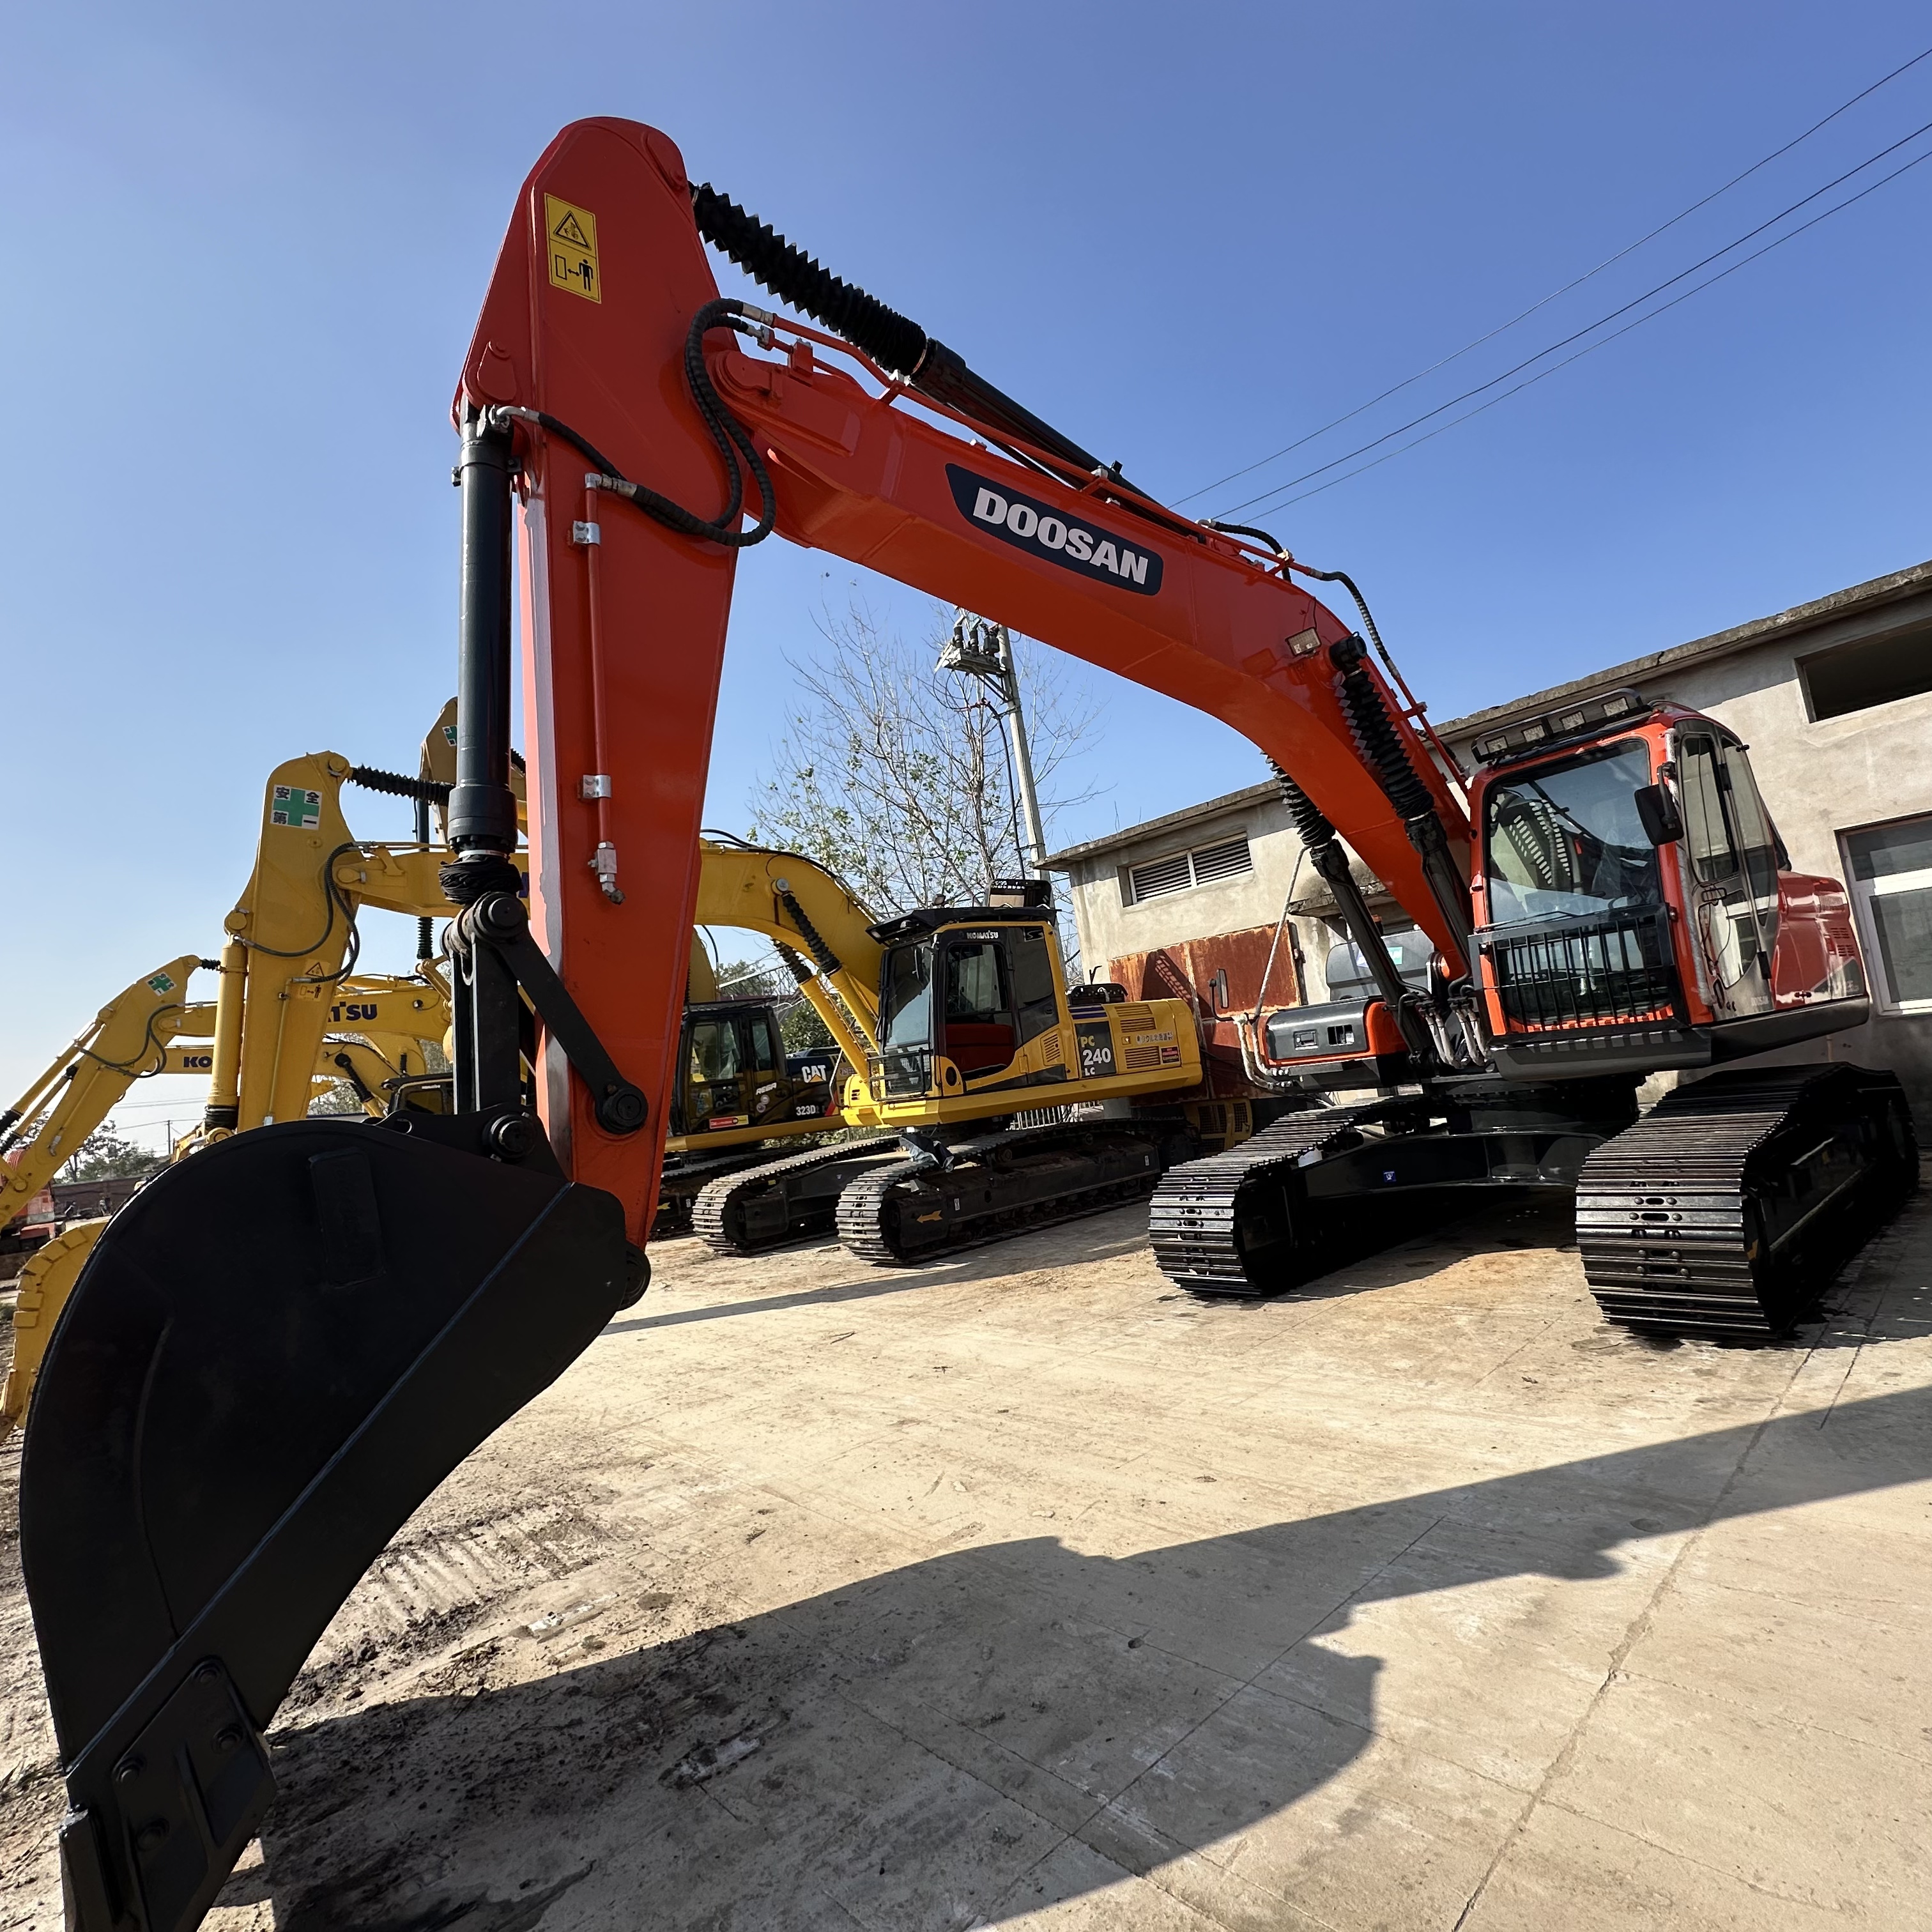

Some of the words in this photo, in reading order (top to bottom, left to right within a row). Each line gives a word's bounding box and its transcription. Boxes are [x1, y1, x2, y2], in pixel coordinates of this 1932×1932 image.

[972, 487, 1149, 585] DOOSAN
[275, 786, 319, 804] 安全
[966, 930, 999, 939] KOMATSU
[1080, 1035, 1095, 1048] PC
[1082, 1047, 1111, 1066] 240
[801, 1064, 827, 1083] CAT
[1084, 1067, 1096, 1076] LC
